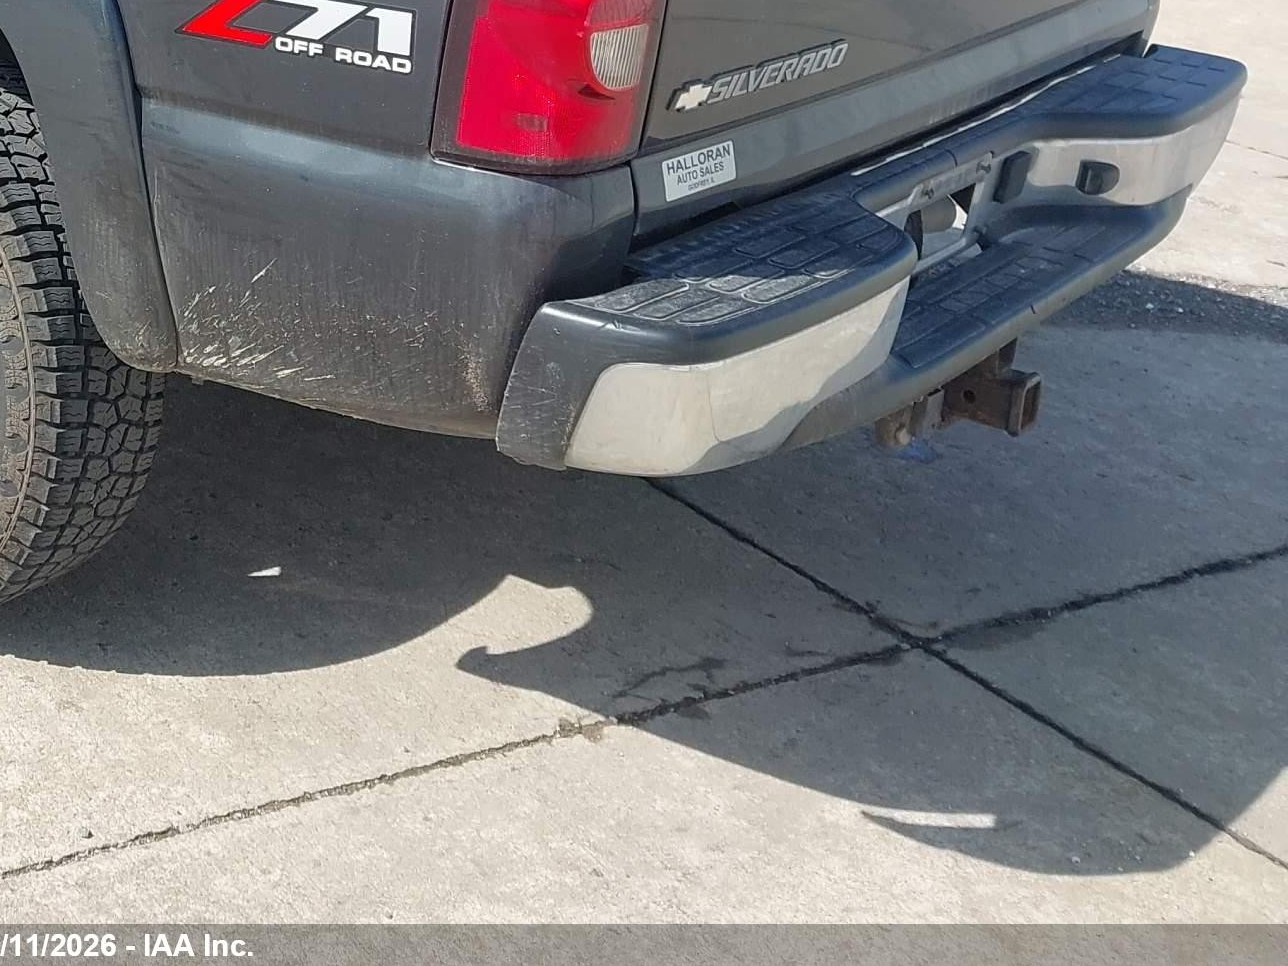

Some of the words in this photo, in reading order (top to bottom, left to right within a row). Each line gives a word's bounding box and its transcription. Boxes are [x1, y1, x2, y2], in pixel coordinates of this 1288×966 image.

[275, 36, 323, 56] OFF
[335, 48, 412, 74] ROAD
[706, 43, 849, 105] SILVERADO
[666, 143, 731, 175] HALLORAN
[677, 170, 698, 186] AUTO
[699, 161, 724, 178] SALES
